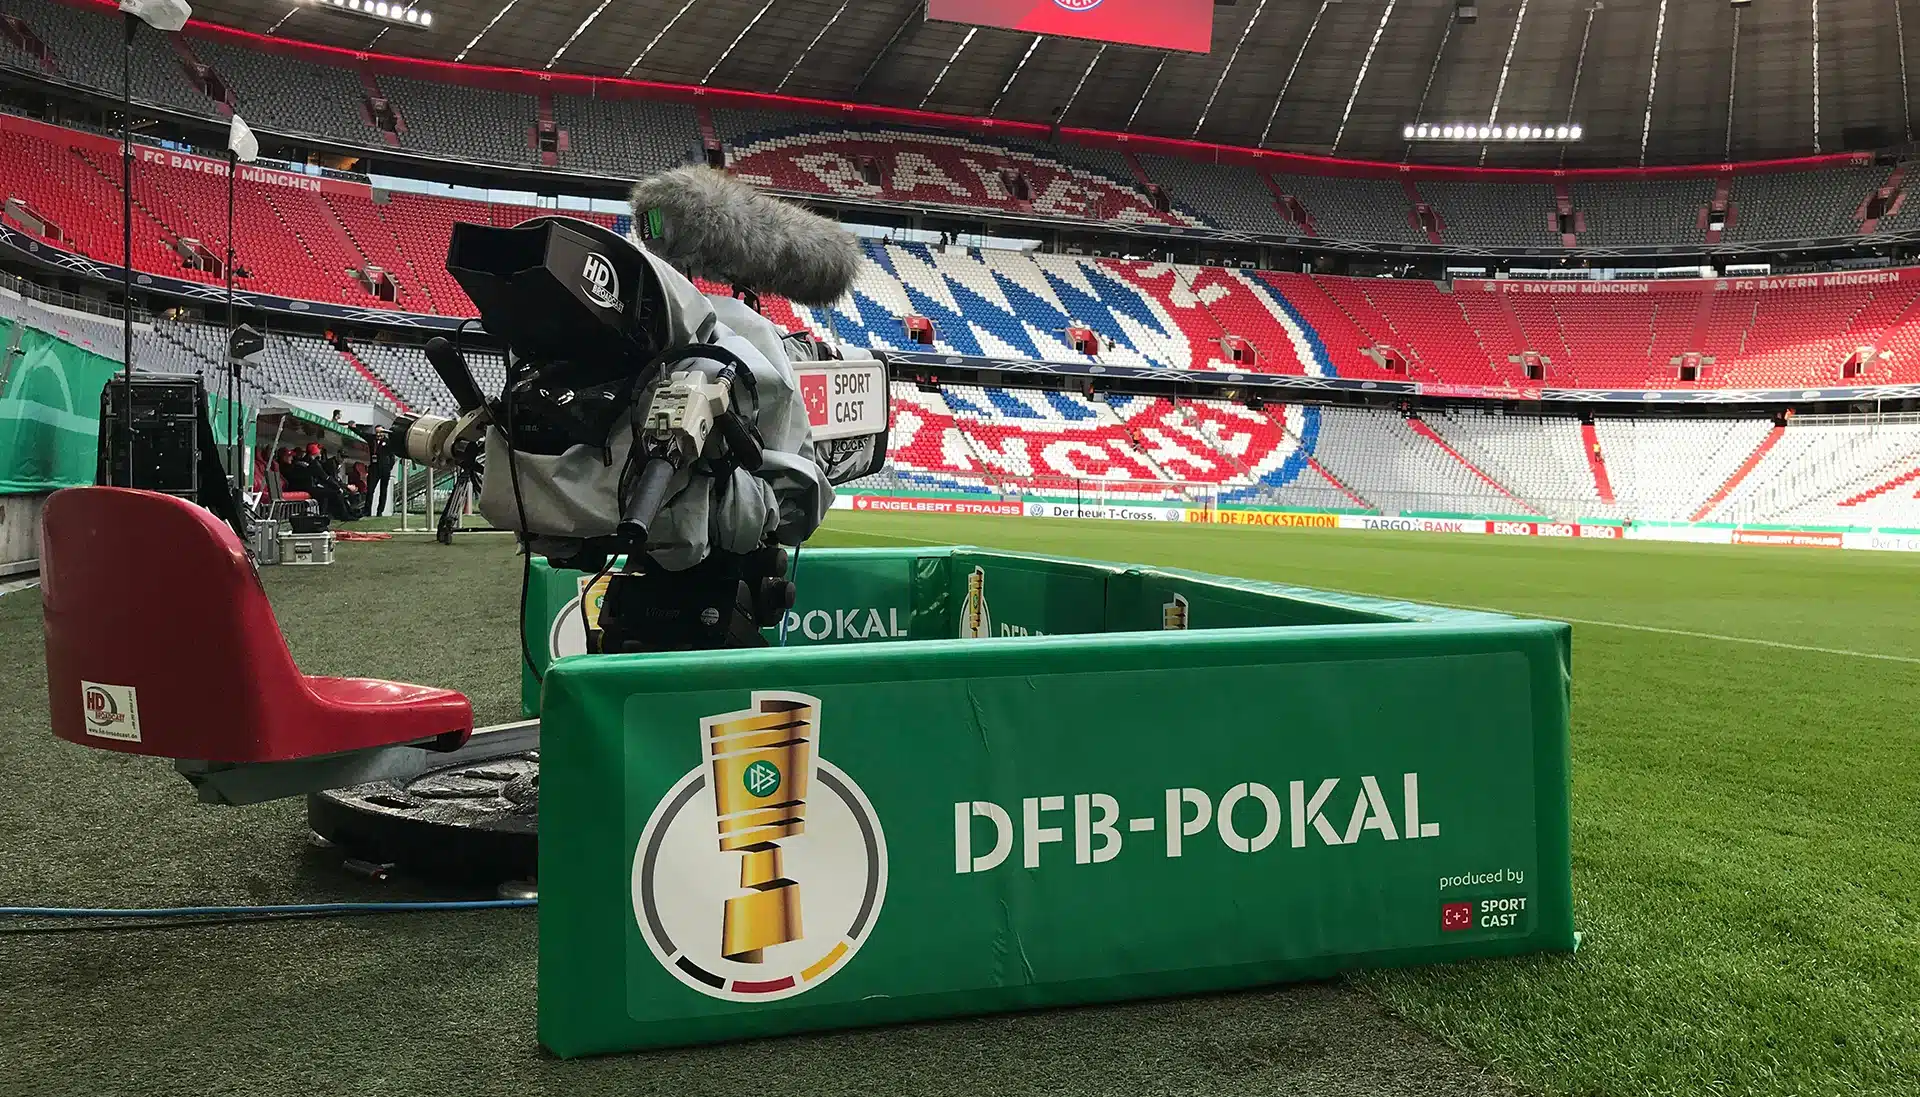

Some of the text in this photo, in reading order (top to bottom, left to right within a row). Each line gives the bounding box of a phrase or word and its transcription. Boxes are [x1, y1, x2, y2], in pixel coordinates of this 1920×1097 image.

[143, 150, 165, 165] FC
[240, 169, 321, 192] MÜNCHEN
[582, 255, 610, 287] HD
[1735, 271, 1900, 291] FC BAYERN MÜNCHEN
[1502, 281, 1649, 293] FC BAYERN MÜNCHEN
[591, 284, 625, 313] BROADCAST
[834, 373, 871, 395] SPORT
[835, 401, 864, 423] CAST
[871, 500, 1021, 515] ENGELBERT STRAUSS
[1053, 506, 1074, 518] Der
[1494, 522, 1616, 539] ERGO ERGO ERGO
[87, 691, 105, 711] HD
[954, 772, 1440, 874] DFB-POKAL
[1440, 868, 1525, 891] produced by
[1481, 898, 1527, 913] SPORT
[1481, 914, 1517, 928] CAST
